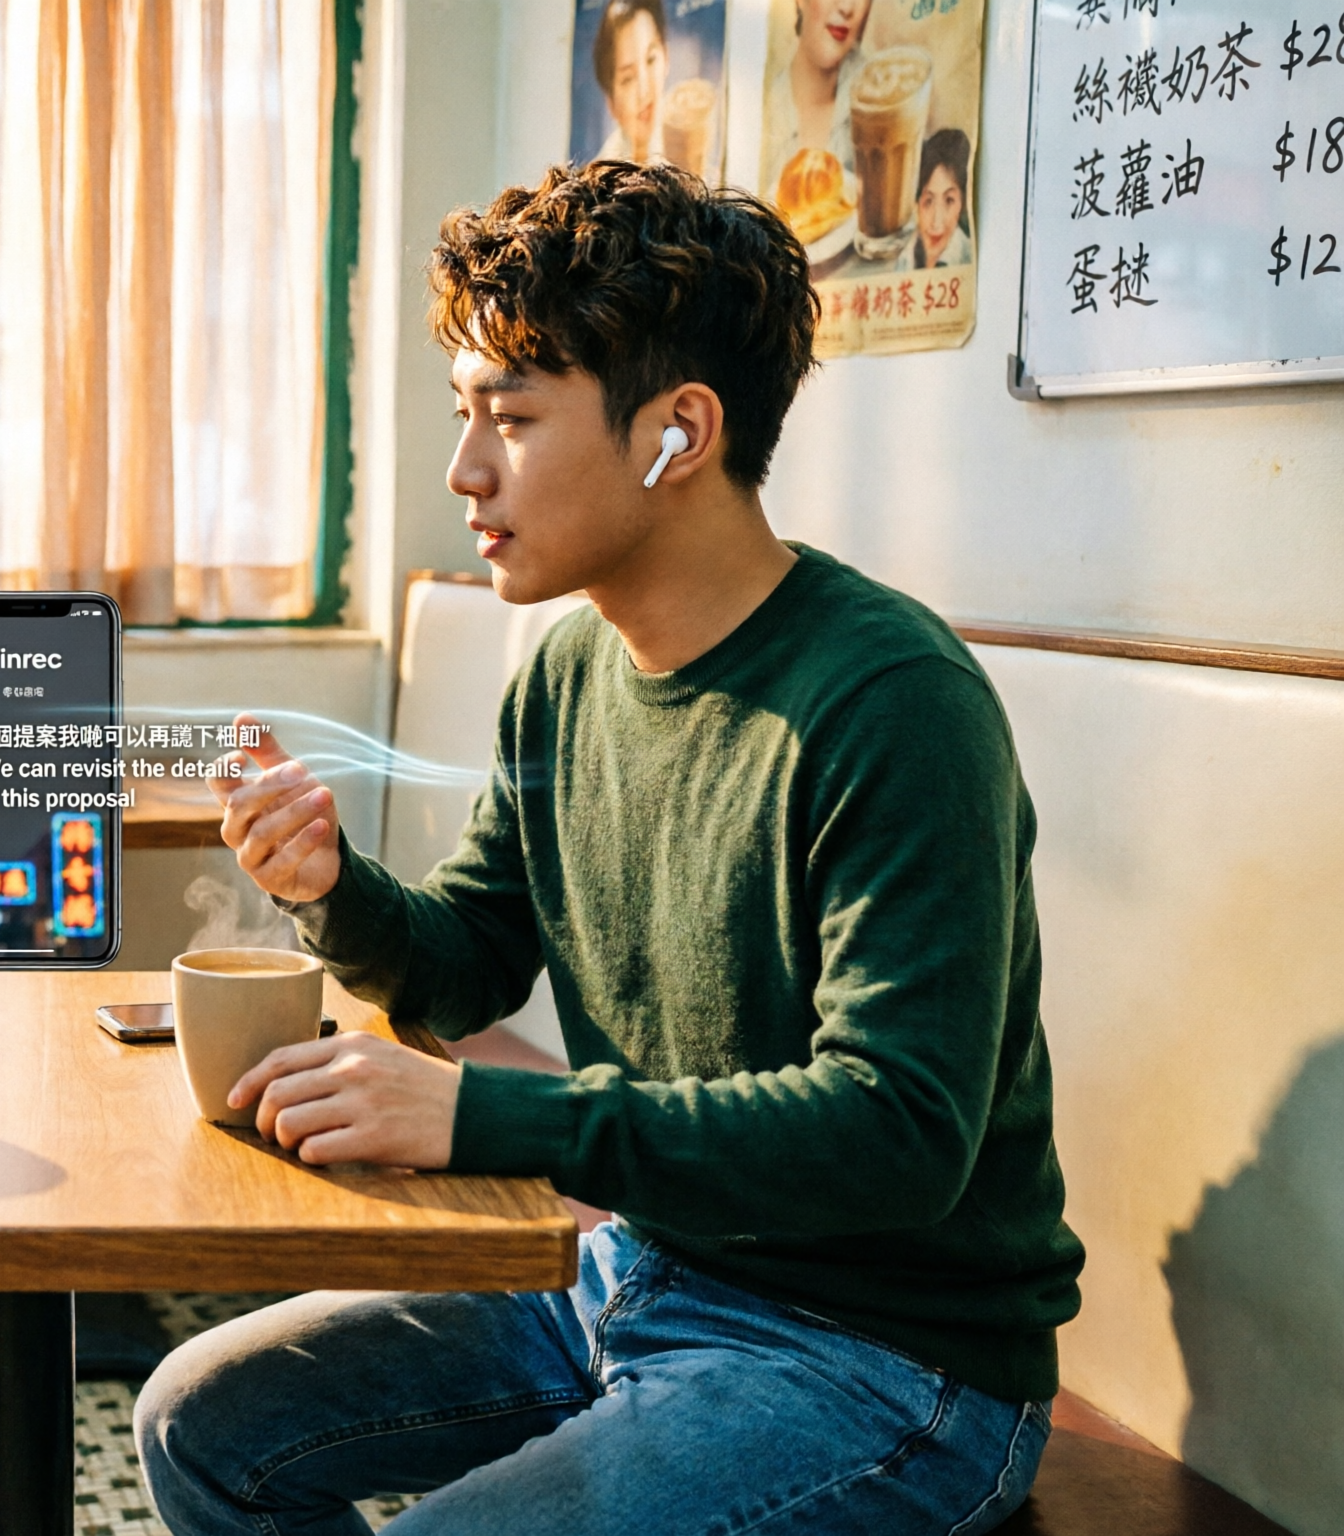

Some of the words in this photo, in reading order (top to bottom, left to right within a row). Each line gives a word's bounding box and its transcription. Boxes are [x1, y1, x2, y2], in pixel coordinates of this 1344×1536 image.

[1072, 20, 1262, 124] 絲襪奶茶
[1070, 138, 1205, 220] 菠蘿油
[1272, 116, 1344, 183] $18
[923, 276, 961, 316] $28
[1267, 225, 1342, 287] $12
